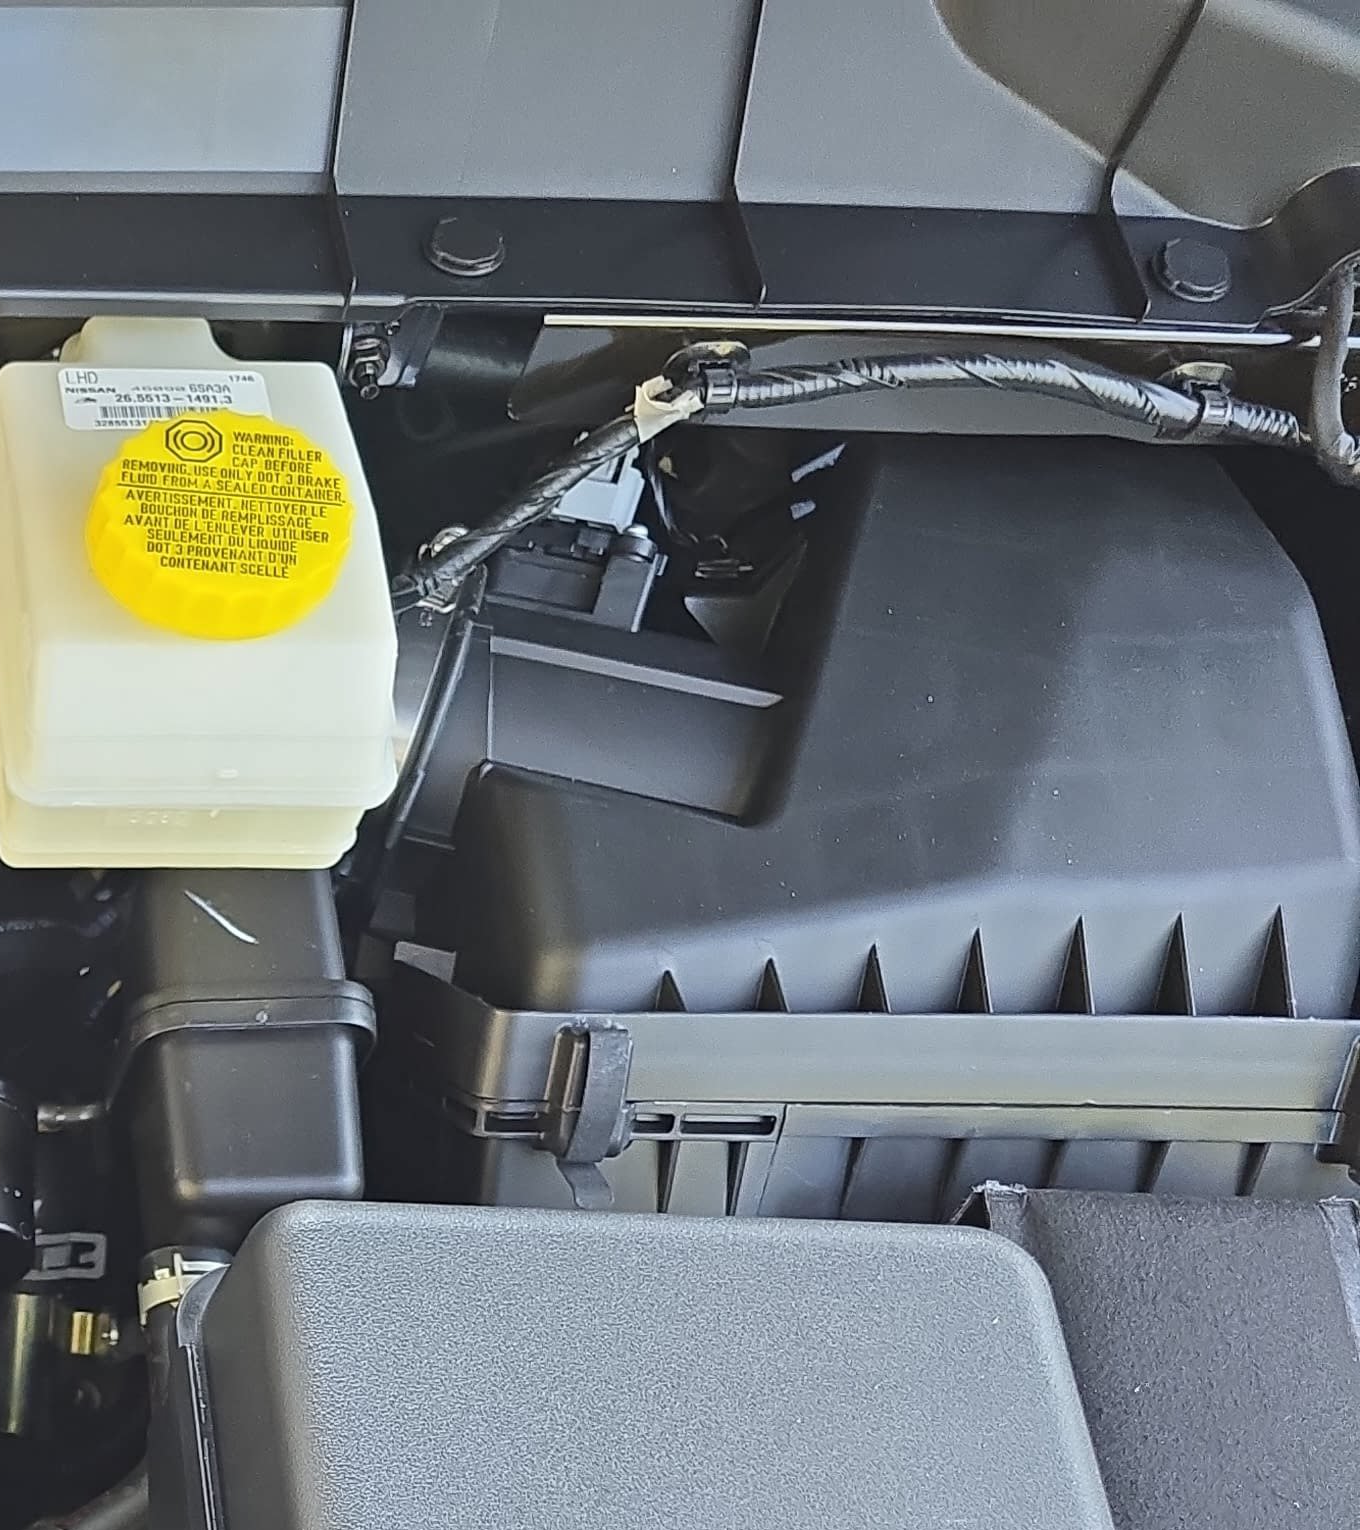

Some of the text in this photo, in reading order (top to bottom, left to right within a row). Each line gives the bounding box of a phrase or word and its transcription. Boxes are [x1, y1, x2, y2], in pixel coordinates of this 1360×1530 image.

[65, 371, 98, 385] LHD
[233, 432, 293, 446] WARNING:
[232, 444, 322, 462] CLEAN FILLER
[232, 457, 312, 473] CAP BEFORE
[121, 472, 157, 485] FLUID
[163, 475, 198, 489] FROM
[203, 479, 211, 489] A
[217, 481, 266, 495] SEALED
[194, 467, 217, 477] USE
[221, 469, 255, 481] ONLY
[258, 472, 280, 483] DOT
[285, 474, 292, 484] 3
[298, 475, 341, 489] BRAKE
[141, 503, 312, 529] BOUCHON DE REMPLISSAGE
[241, 499, 307, 515] NETTOYER
[311, 507, 326, 517] LE
[124, 514, 169, 529] AVANT
[175, 519, 189, 530] DE
[273, 528, 329, 543] UTILISER
[147, 529, 297, 552] SEULEMENT DU LIQUIDE
[147, 542, 172, 553] DOT
[176, 544, 182, 554] 3
[187, 545, 264, 562] PROVENANT
[161, 557, 236, 573] CONTENANT
